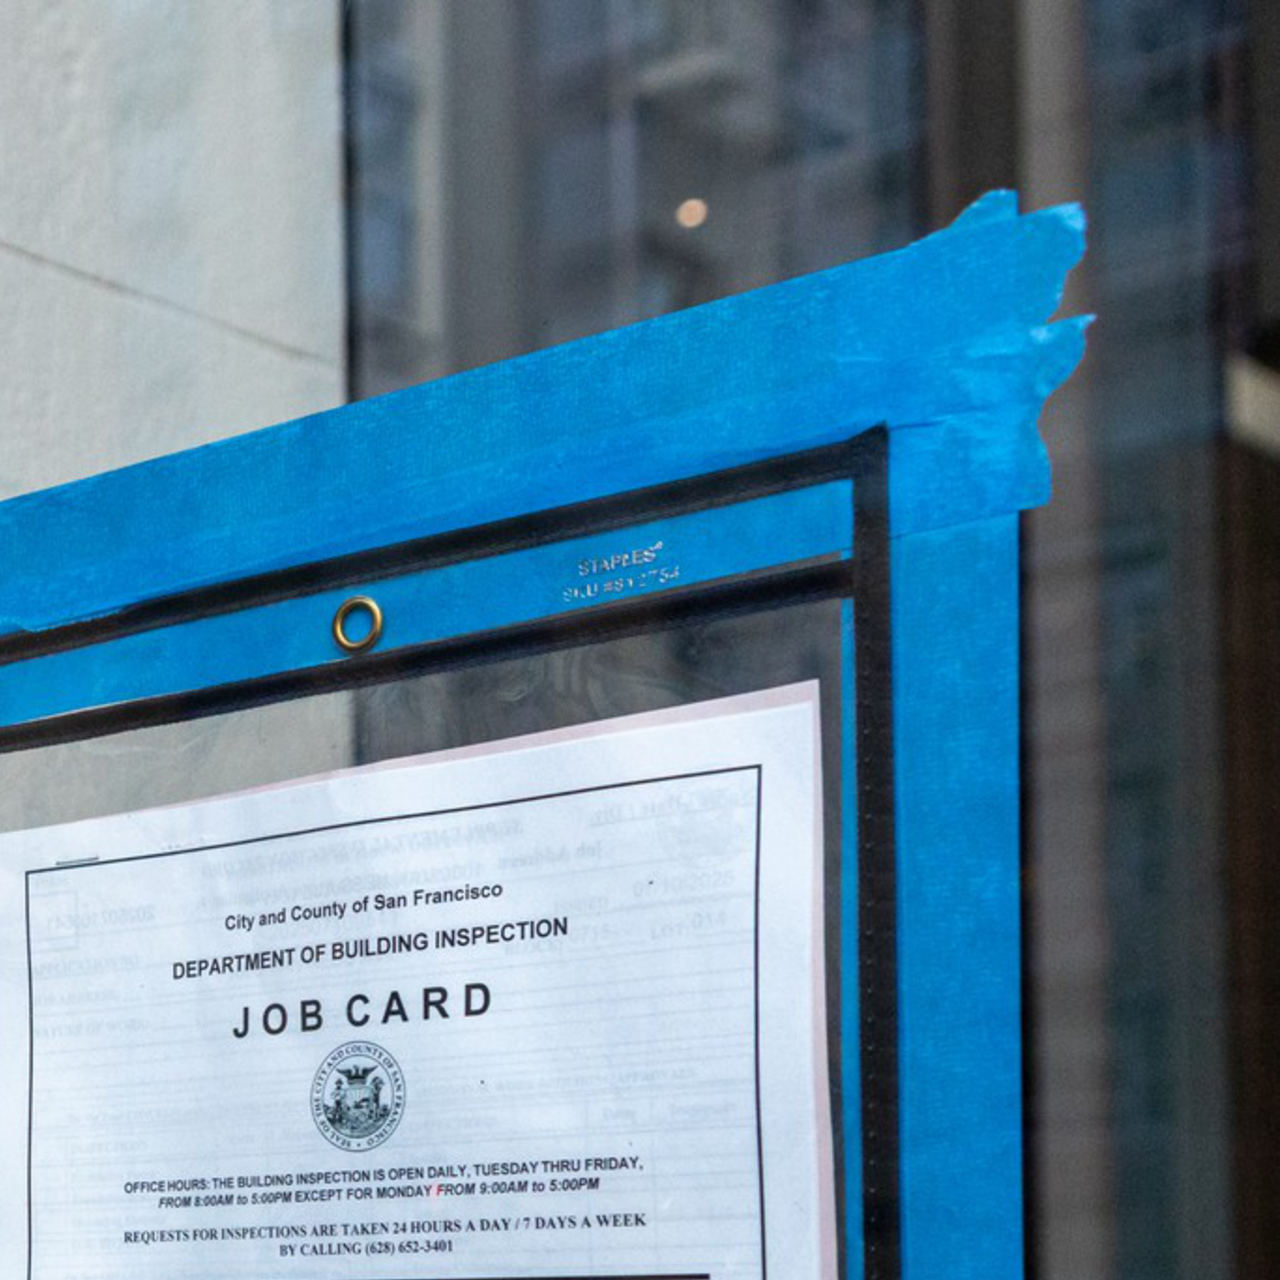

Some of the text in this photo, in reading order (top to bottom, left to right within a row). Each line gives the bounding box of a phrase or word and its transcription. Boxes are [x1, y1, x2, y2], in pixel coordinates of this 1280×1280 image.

[224, 914, 255, 932] City
[258, 908, 286, 926] and
[290, 901, 347, 922] County
[351, 895, 369, 914] of
[373, 894, 407, 911] San
[412, 884, 503, 906] Francisco
[172, 948, 296, 980] DEPARTMENT
[299, 944, 326, 964] OF
[331, 932, 429, 960] BUILDING
[434, 917, 568, 949] INSPECTION
[233, 983, 491, 1039] JOB CARD
[123, 1157, 643, 1194] OFFICE HOURS: THE BUILDING INSPECTION IS OPEN DAILY, TUESDAY THRU FRIDAY,
[157, 1178, 600, 1208] FROM 8:00AM to 5:00PM EXCEPT FOR MONDAY FROM 9:00AM to 5:00PM
[123, 1231, 190, 1245] REQUESTS
[192, 1229, 218, 1241] FOR
[220, 1226, 307, 1240] INSPECTIONS
[309, 1225, 337, 1237] ARE
[340, 1224, 389, 1236] TAKEN
[392, 1223, 407, 1234] 24
[410, 1221, 462, 1234] HOURS
[465, 1221, 476, 1232] A
[479, 1219, 511, 1231] DAY
[522, 1218, 531, 1229] 7
[534, 1217, 577, 1230] DAYS
[580, 1217, 592, 1228] A
[595, 1214, 646, 1227] WEEK
[279, 1241, 453, 1257] BY CALLING (628) 652-3401
